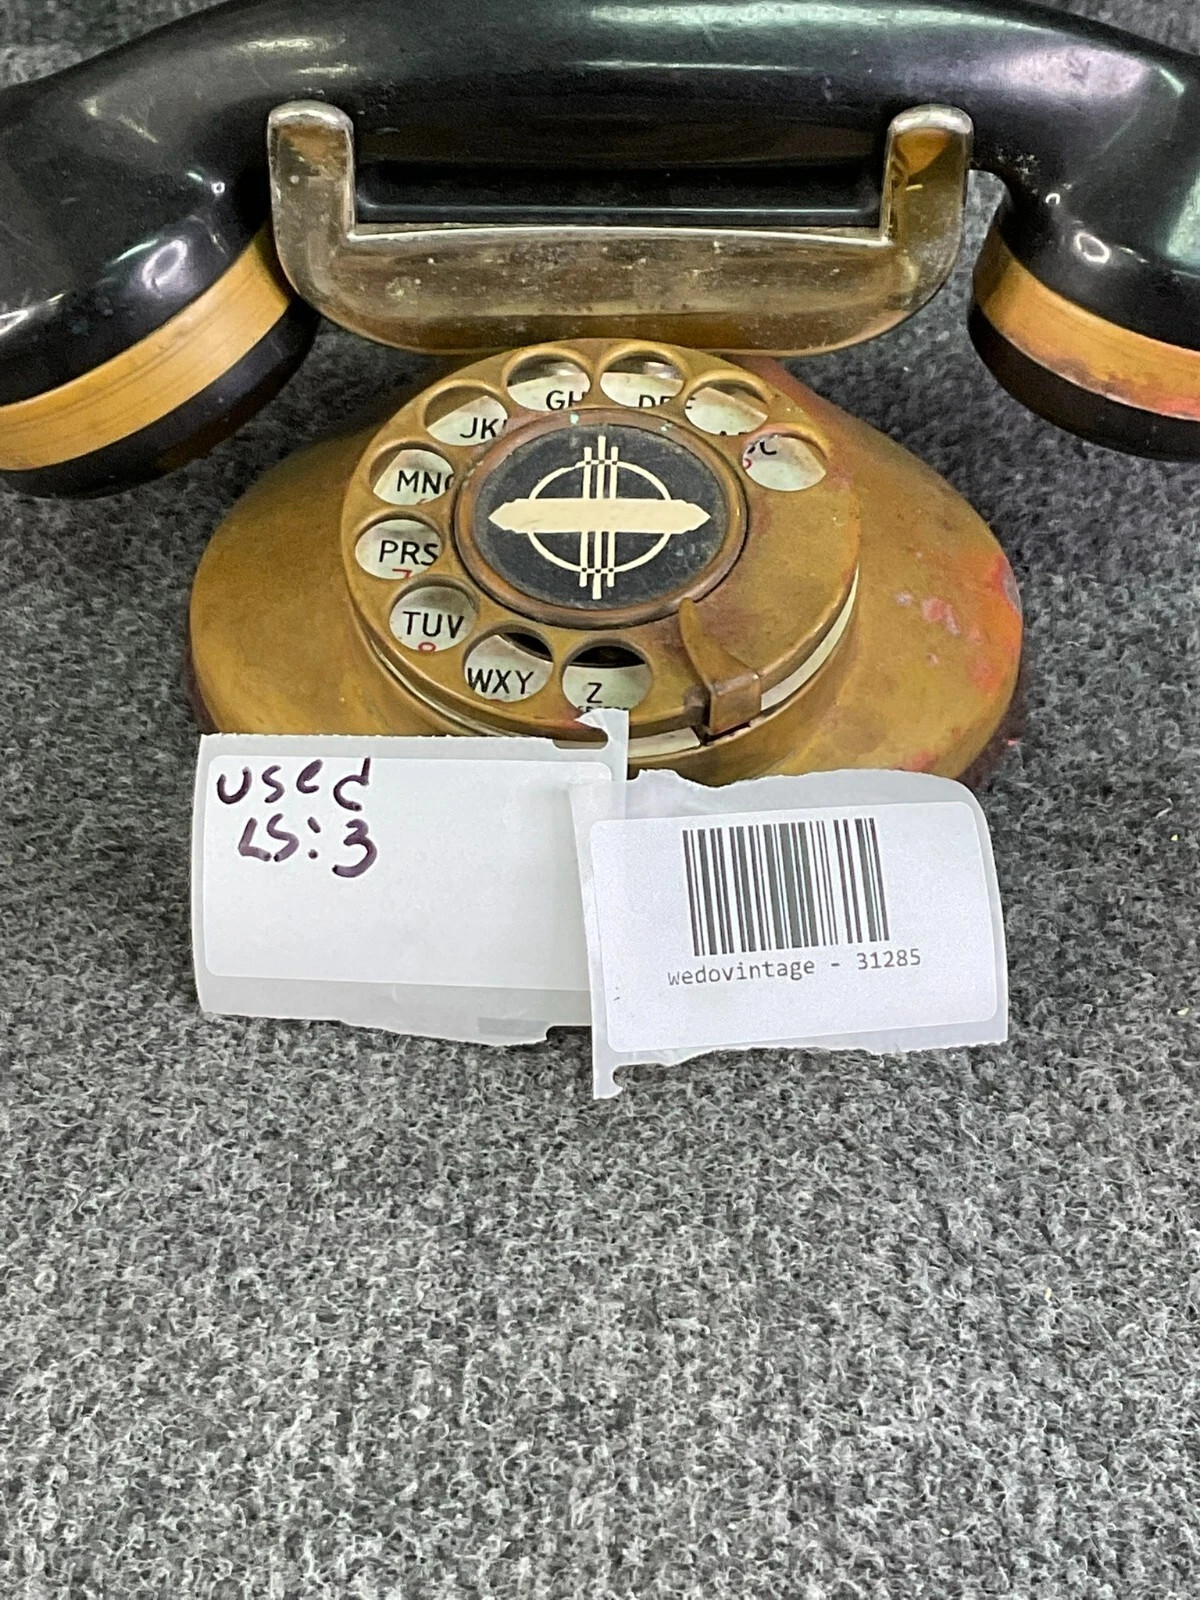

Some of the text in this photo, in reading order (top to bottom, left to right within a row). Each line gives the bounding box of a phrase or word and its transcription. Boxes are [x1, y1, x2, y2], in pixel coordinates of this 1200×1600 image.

[459, 416, 508, 440] JK
[379, 540, 439, 566] PRS
[403, 611, 465, 639] TUV
[467, 668, 534, 695] WXY
[586, 682, 603, 704] Z
[667, 959, 815, 986] wedovintage
[856, 948, 921, 970] 31285
